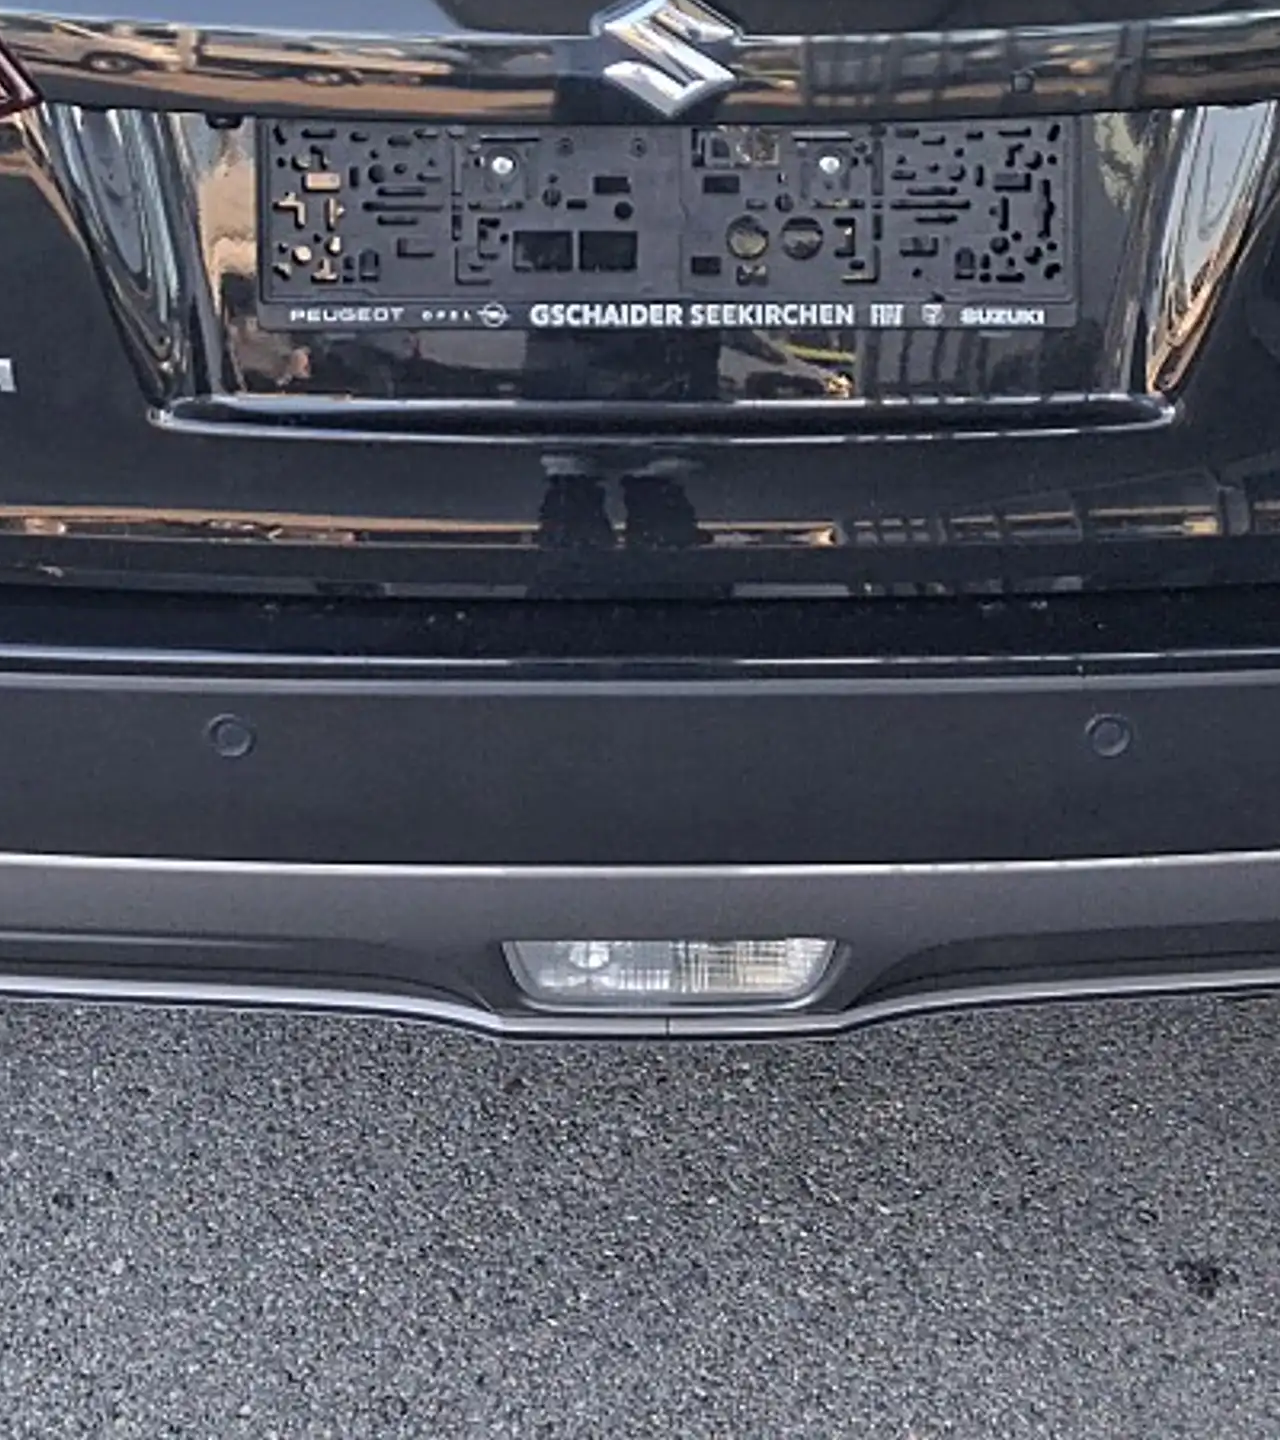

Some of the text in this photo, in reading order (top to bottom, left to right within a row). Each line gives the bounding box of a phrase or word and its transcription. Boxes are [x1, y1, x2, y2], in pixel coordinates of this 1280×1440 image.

[289, 306, 405, 323] PEUGEOT
[529, 303, 683, 327] GSCHAIDER
[689, 303, 854, 326] SEEKIRCHEN
[959, 308, 1046, 325] SUZUKI
